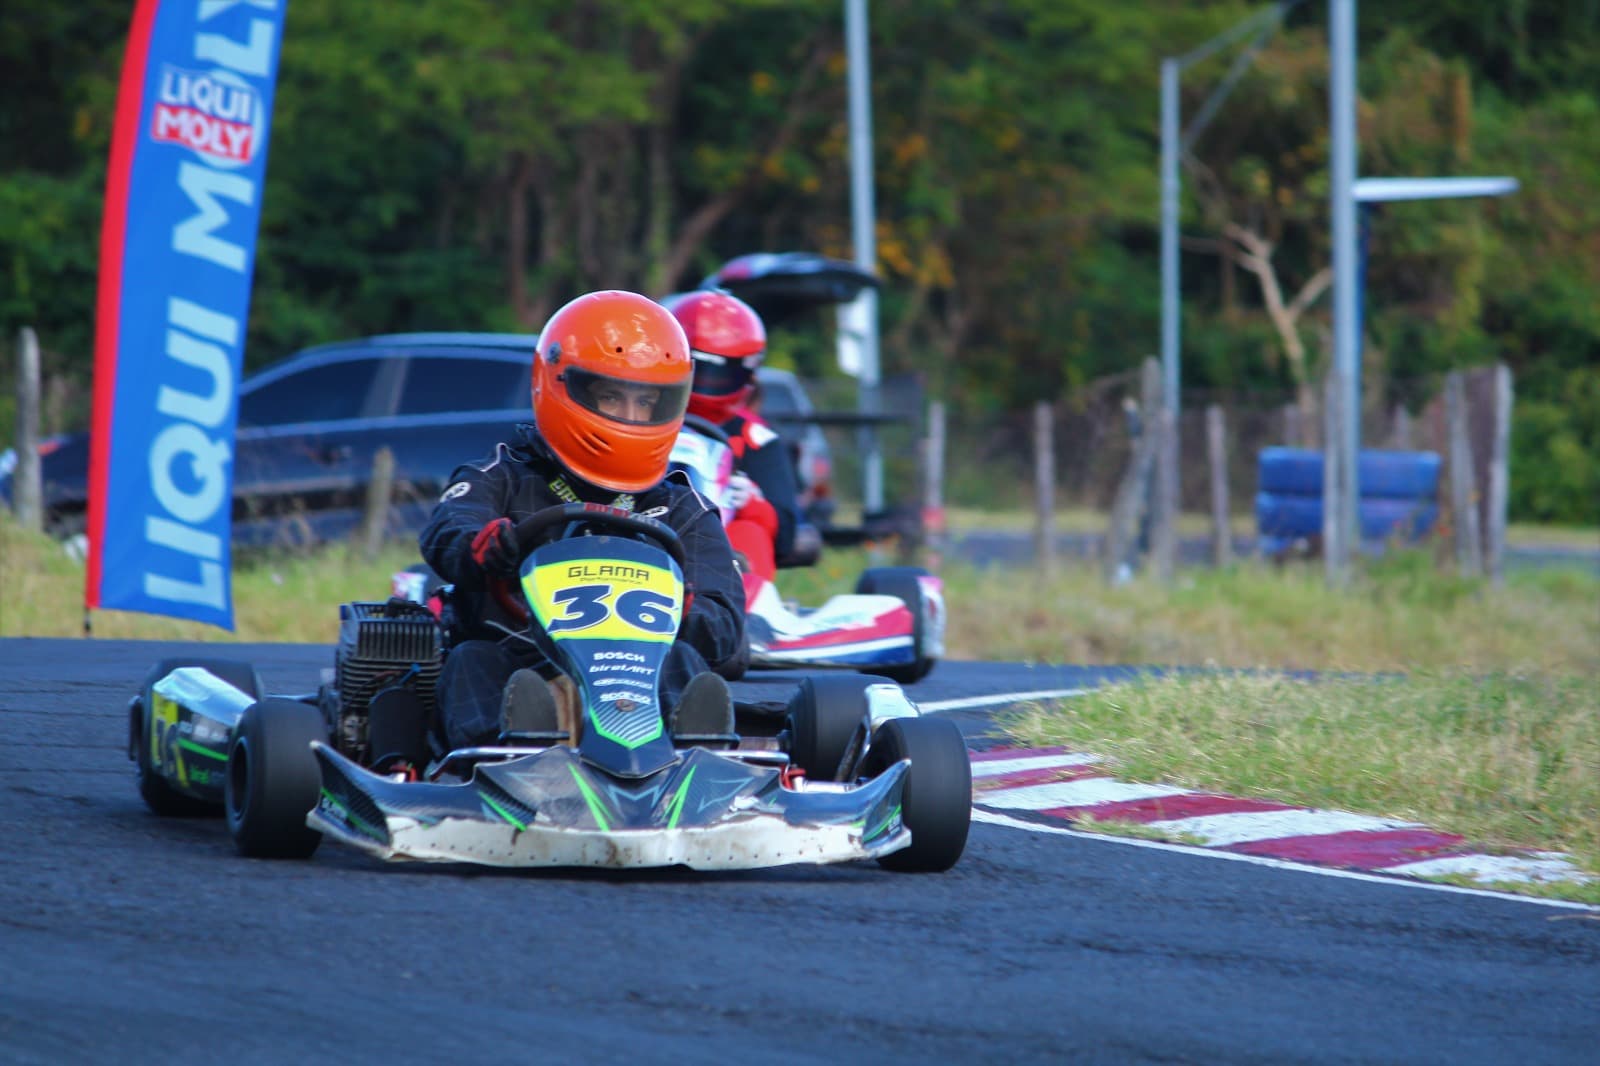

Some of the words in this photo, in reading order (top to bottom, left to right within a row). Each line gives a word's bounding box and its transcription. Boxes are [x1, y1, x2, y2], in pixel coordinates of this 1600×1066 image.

[162, 72, 251, 121] LIQUI
[157, 107, 249, 155] MOLY
[144, 296, 238, 611] LIQUI
[568, 565, 650, 581] GLAMA
[546, 584, 679, 635] 36
[593, 652, 646, 662] BOSCH
